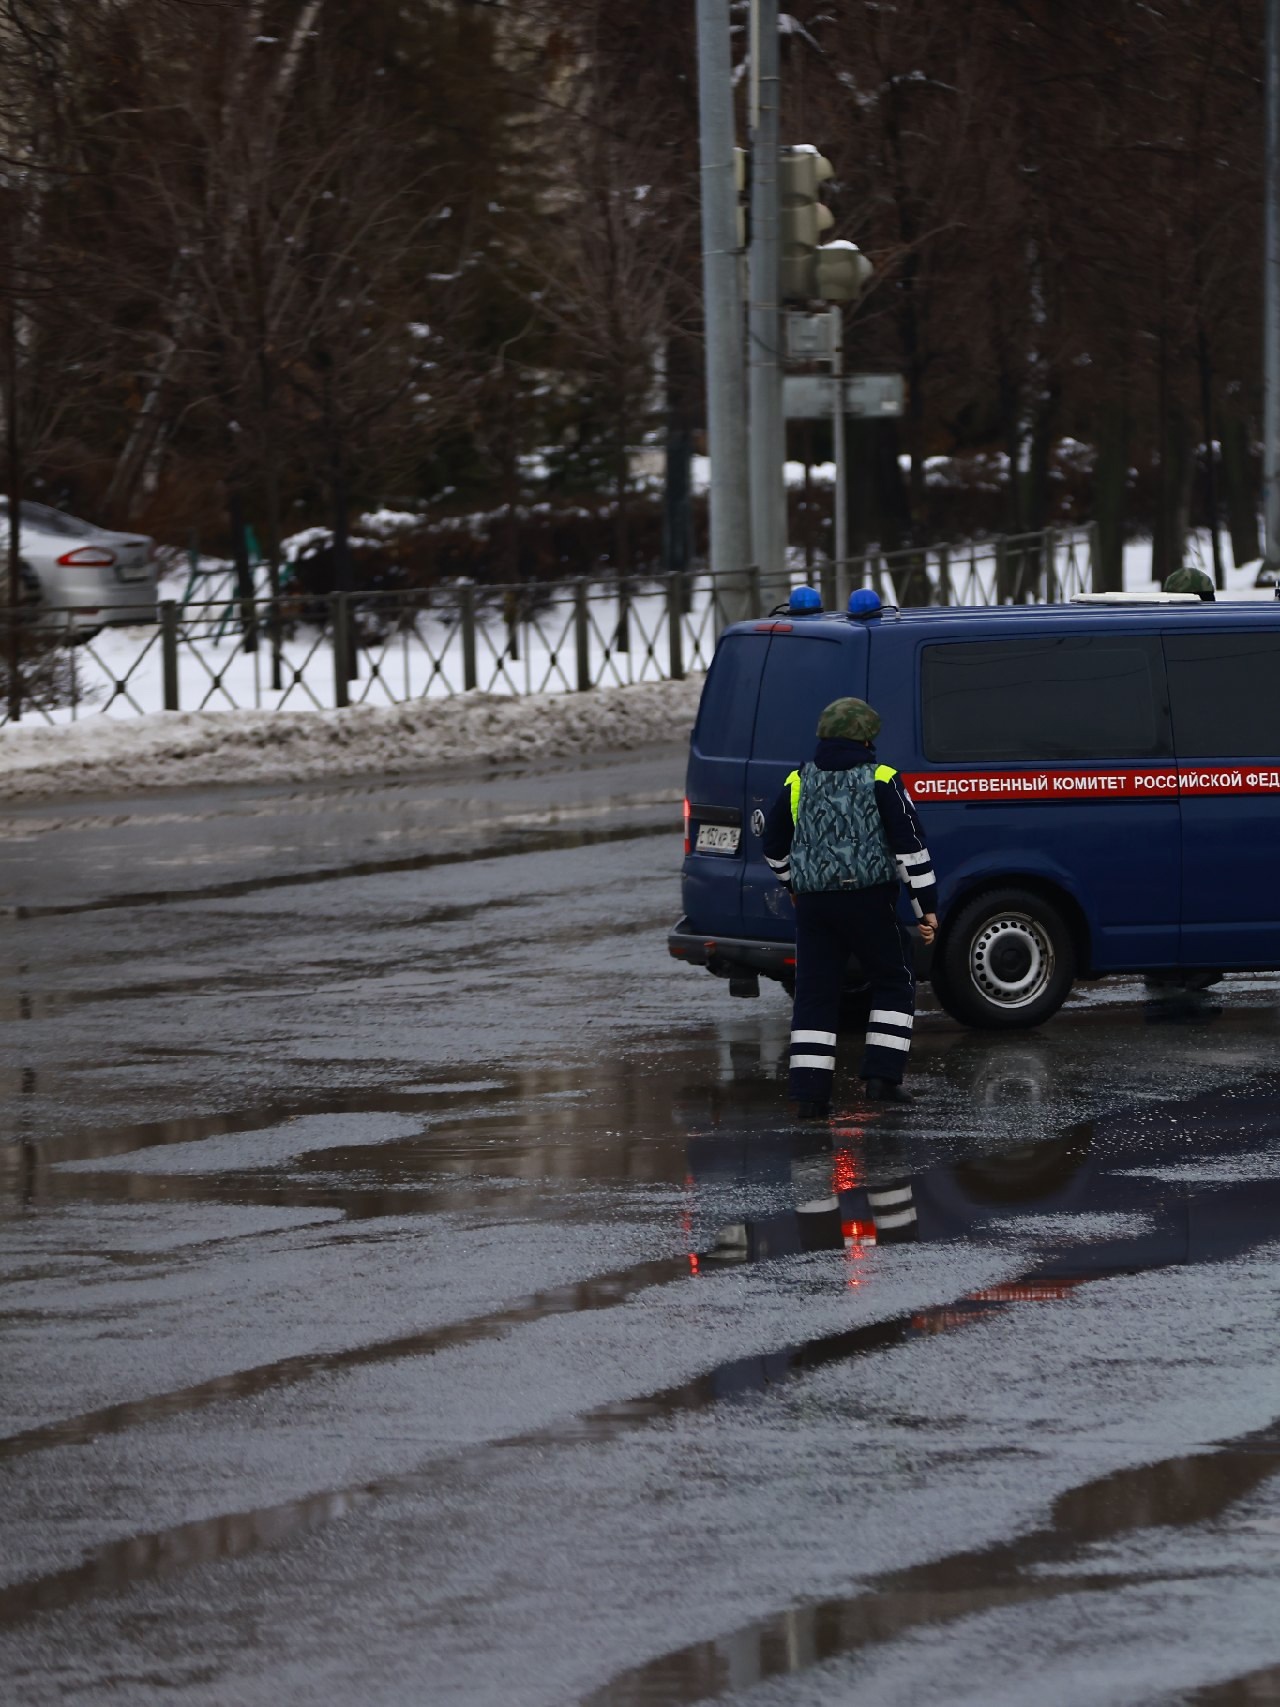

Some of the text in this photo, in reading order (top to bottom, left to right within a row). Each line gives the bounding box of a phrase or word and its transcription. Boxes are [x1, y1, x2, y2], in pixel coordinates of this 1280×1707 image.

[914, 775, 1048, 795] СЛЕДСТВЕННЫЙ
[1053, 776, 1127, 790] КОМИТЕТ
[1134, 771, 1242, 789] РОССИЙСКОЙ
